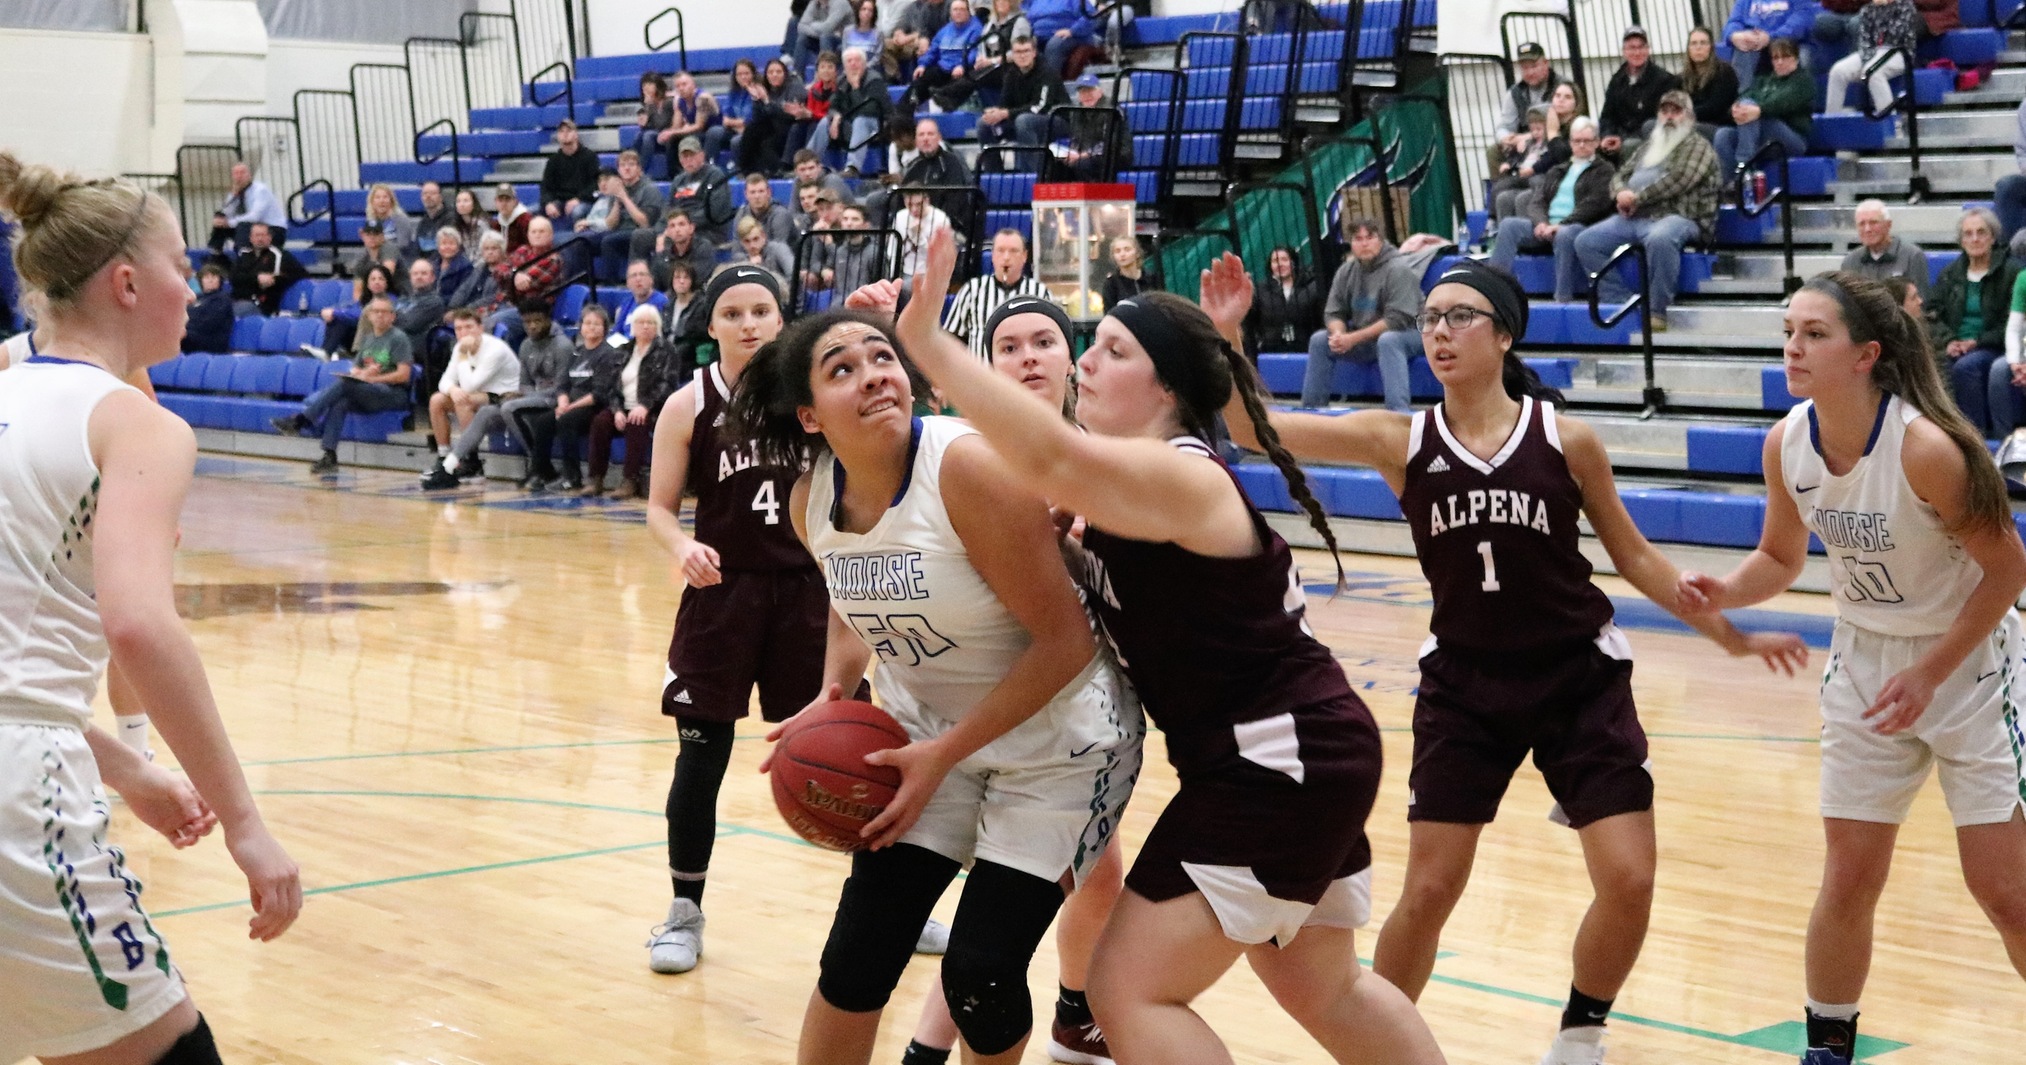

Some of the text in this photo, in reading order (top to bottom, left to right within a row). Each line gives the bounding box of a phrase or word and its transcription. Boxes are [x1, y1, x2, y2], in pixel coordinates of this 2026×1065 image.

[751, 480, 780, 525] 4
[1430, 488, 1551, 538] ALPENA
[1811, 506, 1896, 553] NORSE
[829, 552, 930, 601] NORSE
[1477, 541, 1500, 592] 1
[1841, 556, 1905, 604] 10
[847, 613, 960, 666] 50
[804, 779, 889, 821] SPALDI
[112, 921, 145, 971] B
